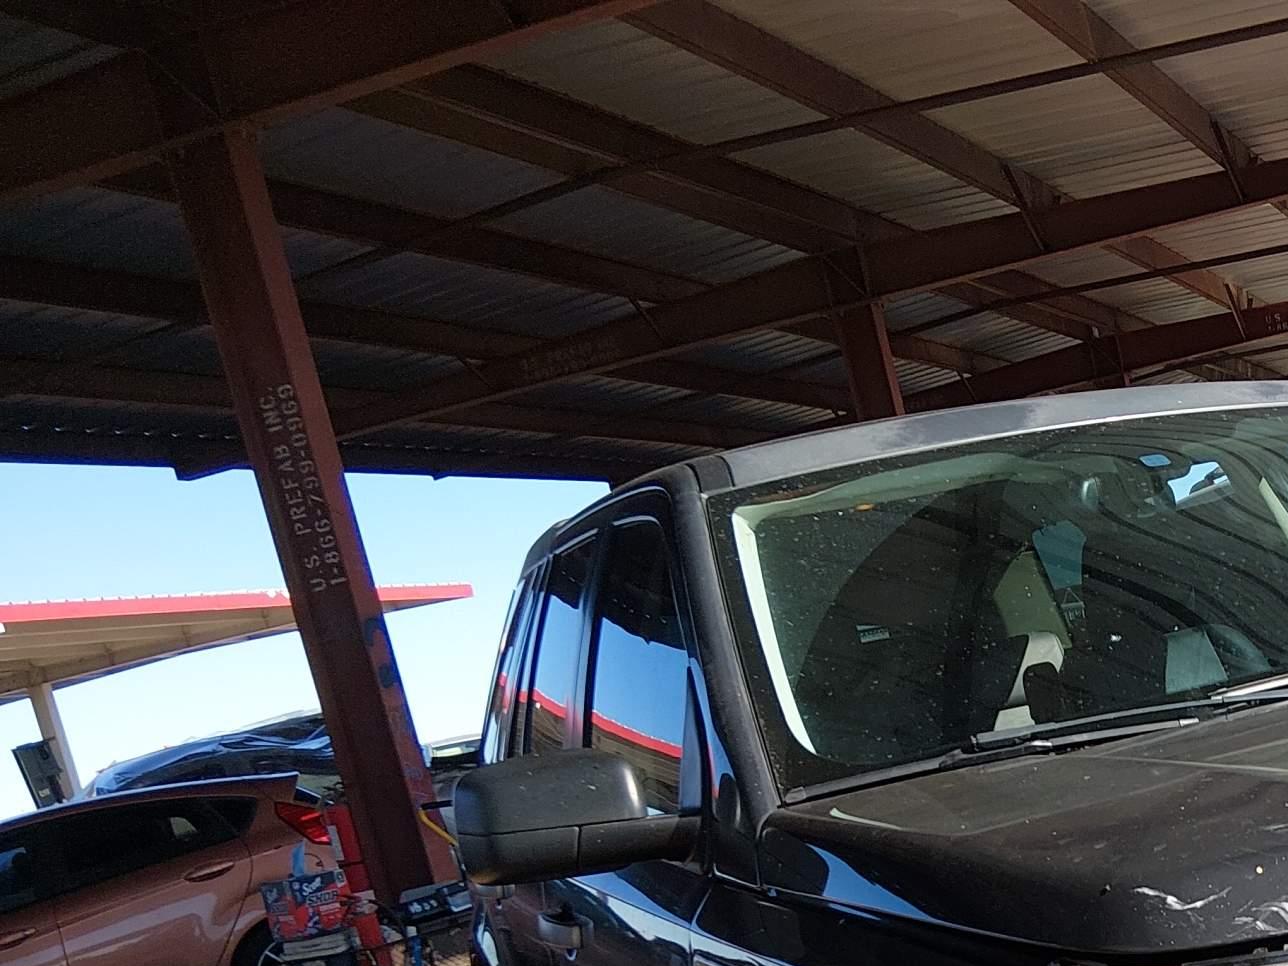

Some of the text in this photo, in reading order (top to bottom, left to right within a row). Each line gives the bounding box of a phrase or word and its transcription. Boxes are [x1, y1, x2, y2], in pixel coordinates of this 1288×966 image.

[274, 445, 312, 536] PREFAB
[277, 384, 348, 586] 1-866-799-0969
[304, 547, 327, 593] U.S.
